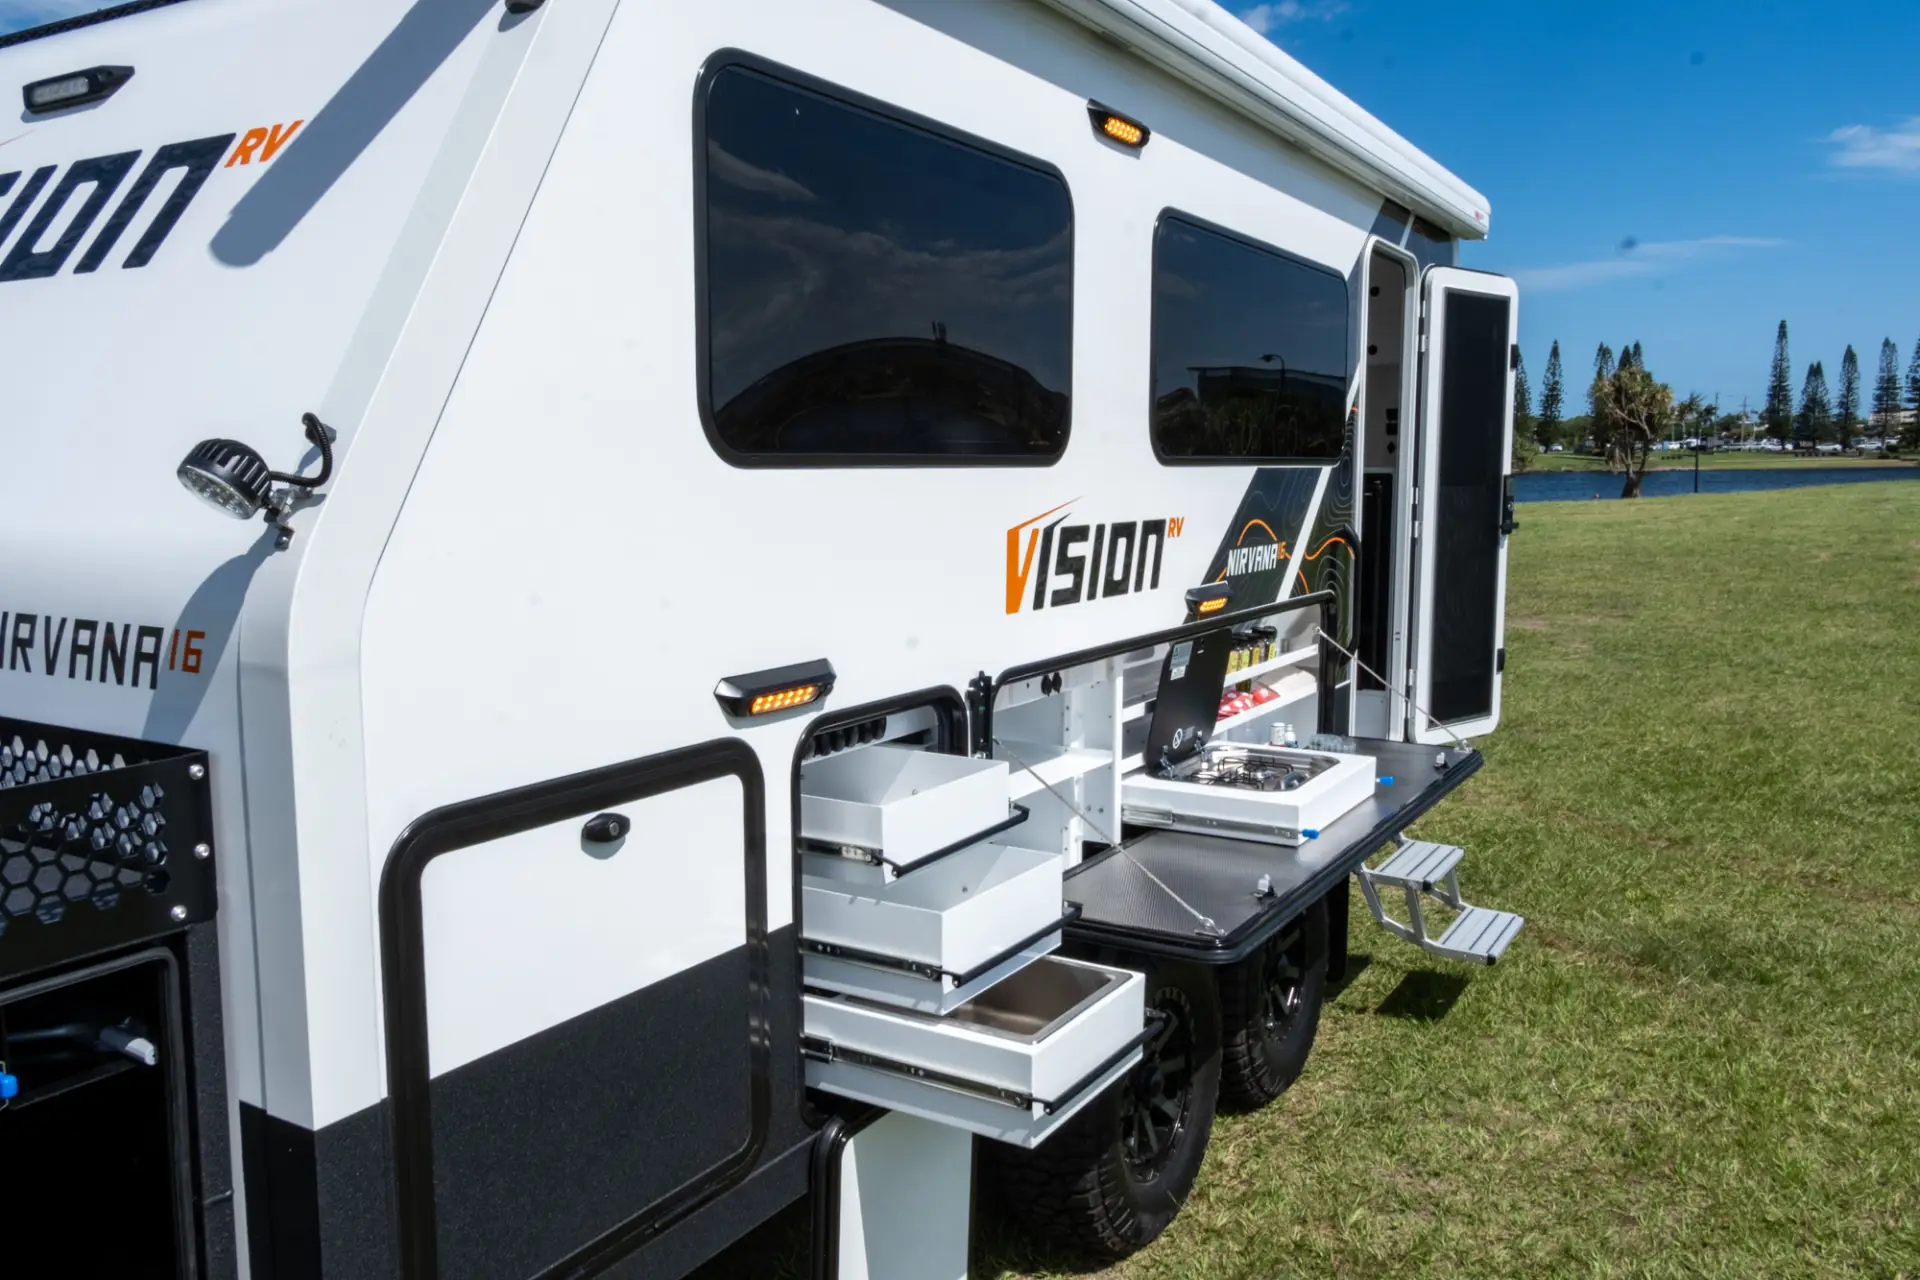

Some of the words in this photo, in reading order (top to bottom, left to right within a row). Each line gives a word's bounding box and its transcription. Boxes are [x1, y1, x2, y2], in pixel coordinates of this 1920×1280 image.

[0, 133, 237, 283] ION
[224, 119, 304, 168] RV
[1005, 497, 1167, 615] VISION
[1167, 516, 1185, 538] RV
[1226, 543, 1279, 577] NIRVANA
[169, 628, 206, 674] 16
